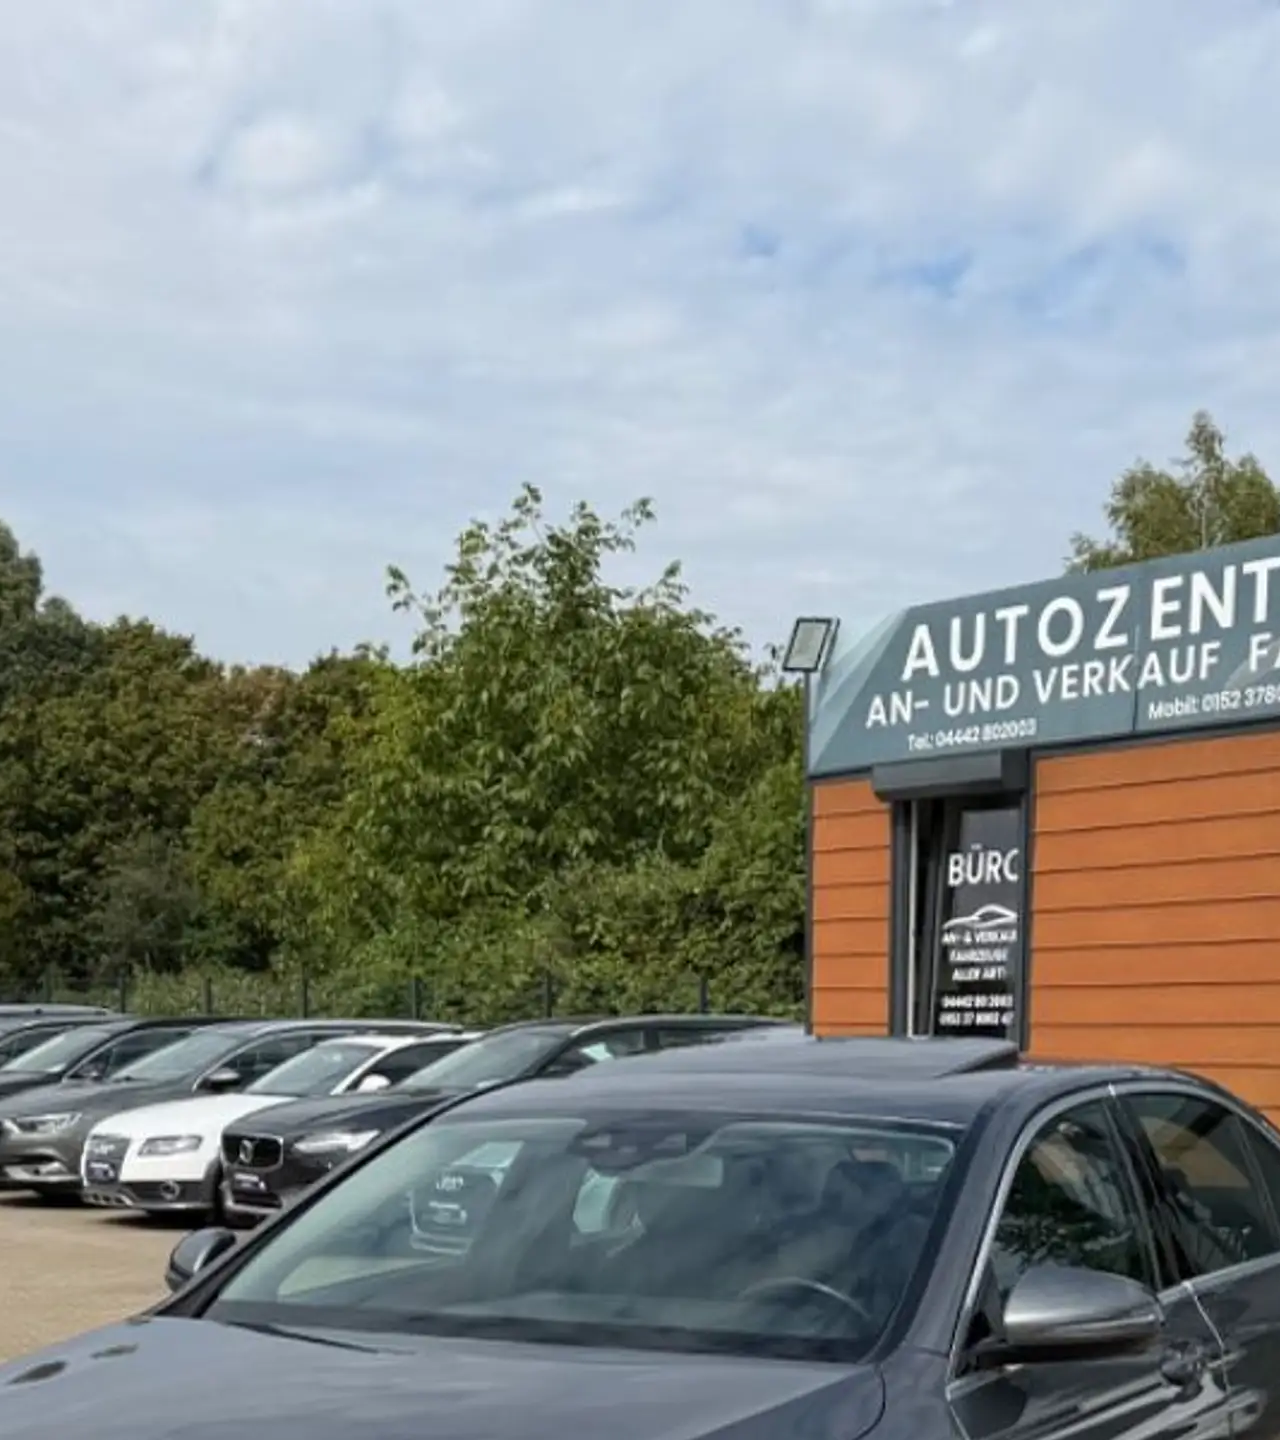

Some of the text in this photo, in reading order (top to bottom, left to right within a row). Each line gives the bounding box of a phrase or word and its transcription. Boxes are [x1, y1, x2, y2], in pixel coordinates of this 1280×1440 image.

[865, 689, 929, 729] AN-
[943, 674, 1020, 717] UND
[1032, 641, 1220, 705] VERKAUF
[1201, 688, 1241, 712] 0152
[935, 726, 980, 748] 04442
